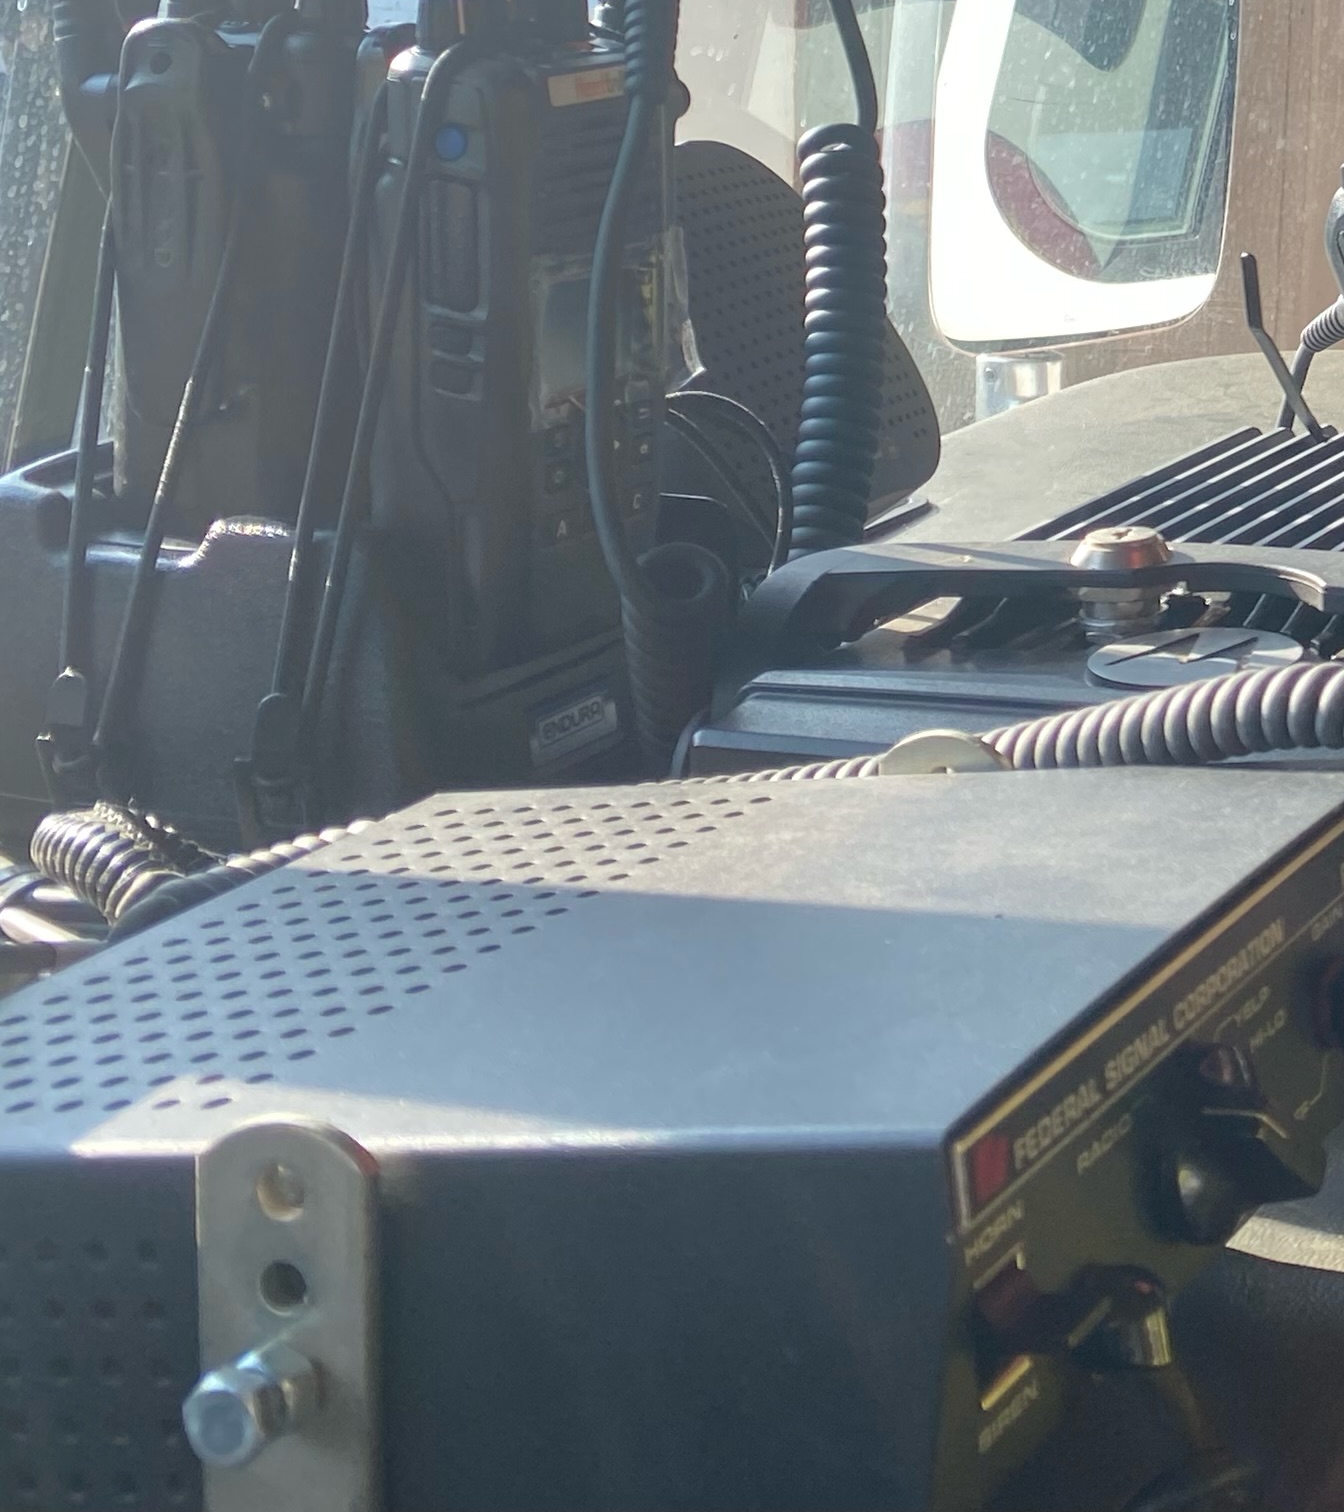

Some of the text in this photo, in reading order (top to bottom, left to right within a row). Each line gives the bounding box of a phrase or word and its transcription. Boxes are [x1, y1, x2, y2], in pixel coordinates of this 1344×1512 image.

[1013, 916, 1286, 1170] FEDERAL SIGNAL CORPORATION
[963, 1198, 1025, 1267] HORN
